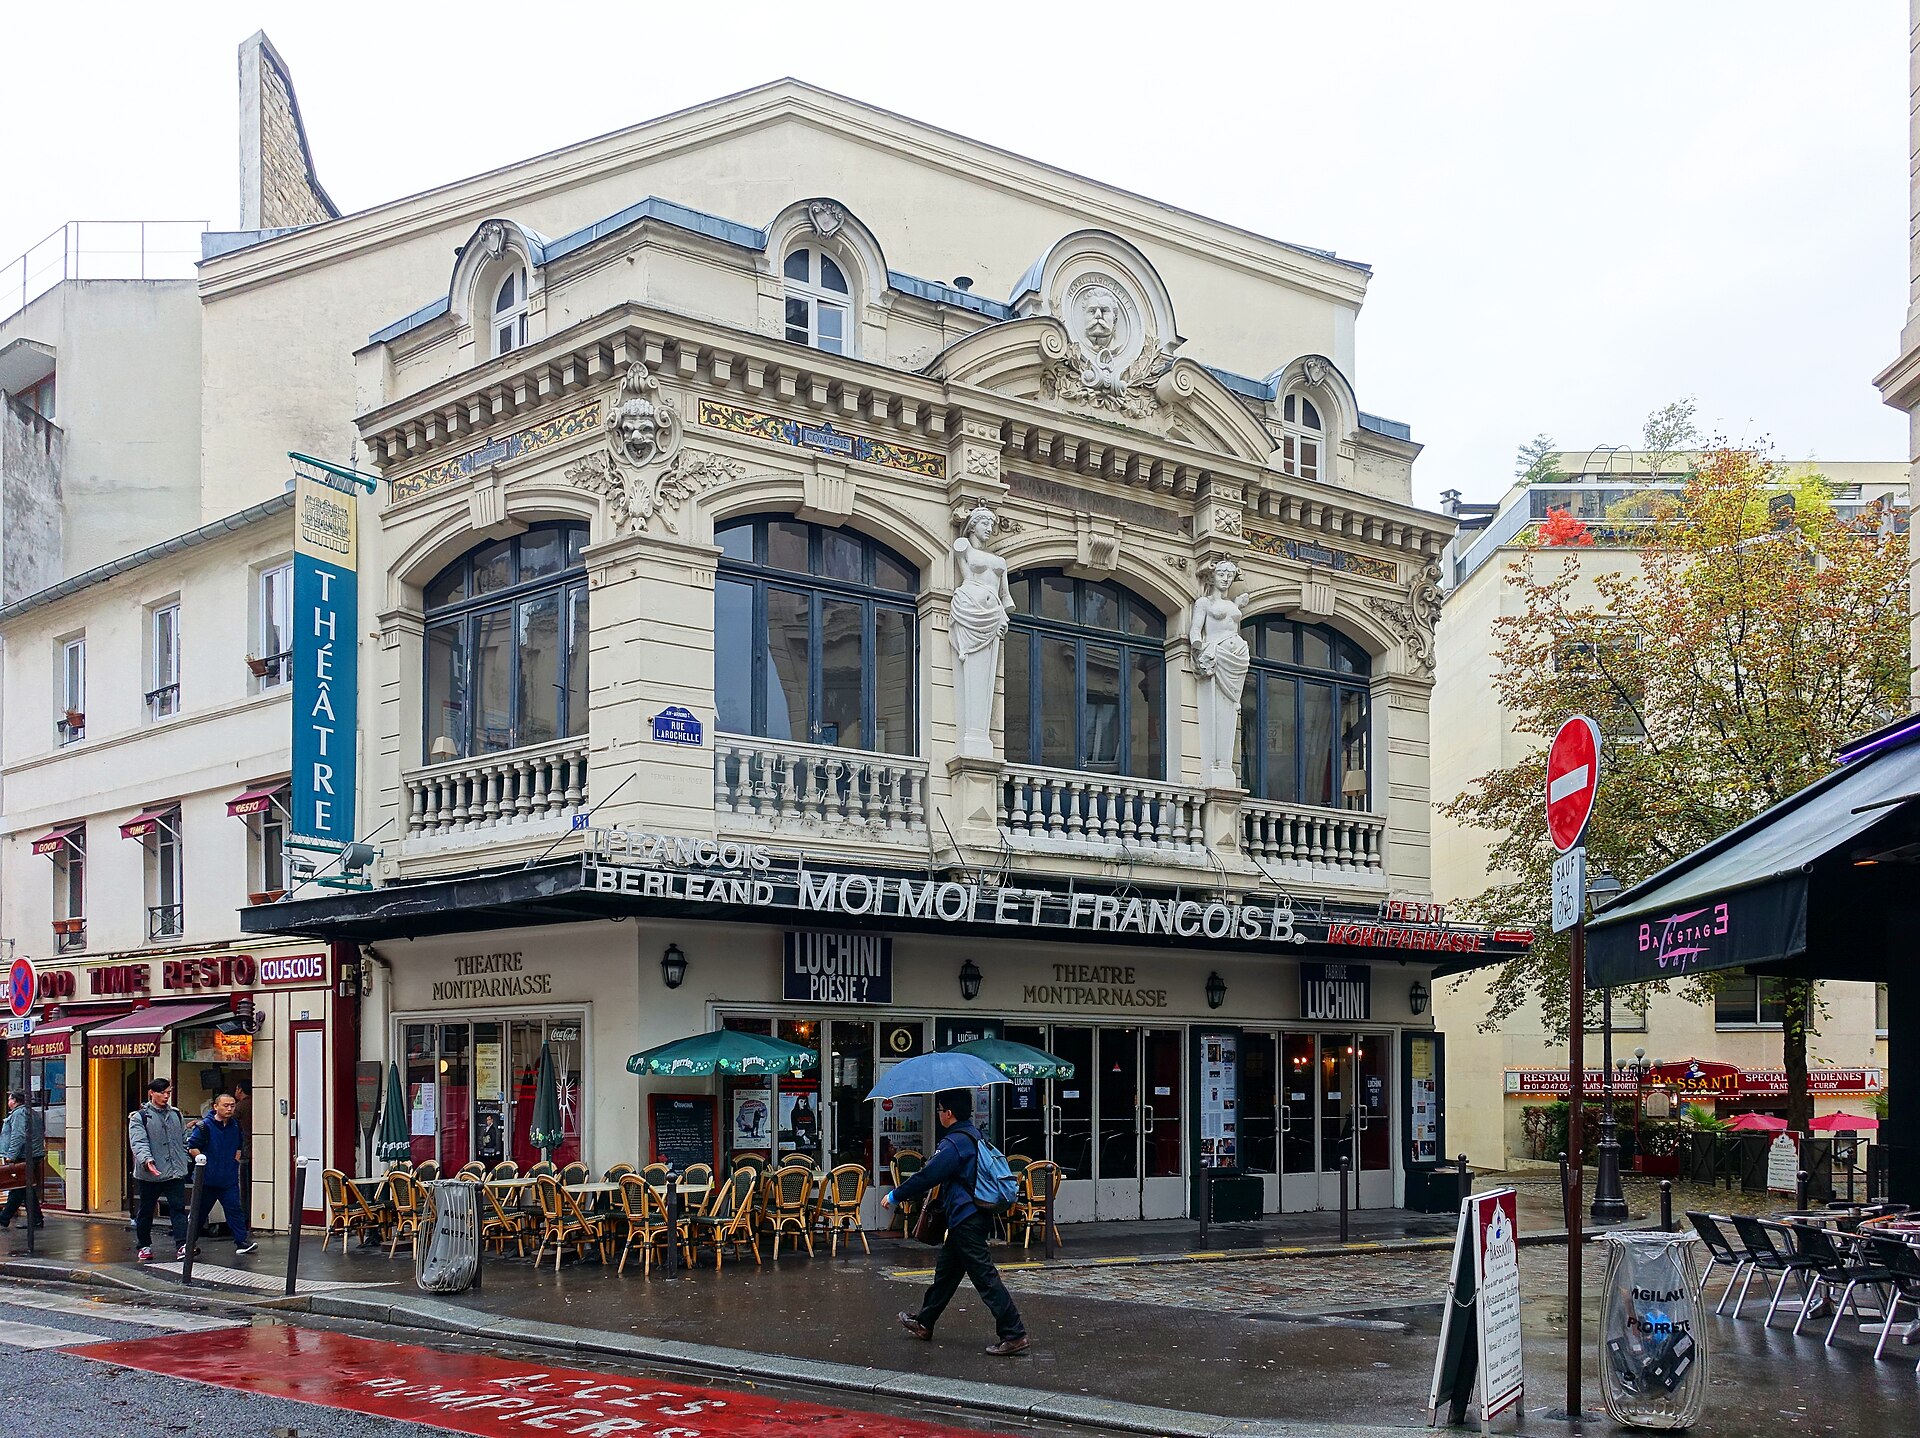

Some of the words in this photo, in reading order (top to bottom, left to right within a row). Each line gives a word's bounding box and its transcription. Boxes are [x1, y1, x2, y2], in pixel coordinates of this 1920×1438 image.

[311, 569, 337, 832] THÉÂTRE
[656, 728, 699, 742] LAROCHELLE
[671, 721, 685, 731] RUE
[235, 801, 259, 814] RESTO
[129, 824, 146, 835] TIME
[38, 843, 57, 852] GOOD
[1556, 855, 1575, 883] SAUF
[596, 867, 775, 906] BERLEAND
[798, 869, 885, 916] MOI
[898, 878, 979, 922] MOI
[996, 887, 1053, 927] ET
[1069, 893, 1264, 941] FRANCOIS
[1386, 900, 1446, 923] PETIT
[1327, 923, 1487, 953] MONTPARNASSE
[454, 951, 523, 976] THEATRE
[794, 931, 882, 977] LUCHINI
[86, 963, 150, 995] TIME
[162, 954, 256, 990] RESTO
[261, 956, 323, 981] COUSCOUS
[1053, 963, 1136, 985] THEATRE
[1325, 964, 1347, 980] FABRICE
[431, 973, 552, 1001] MONTPARNASSE
[810, 972, 857, 1002] POÉSIE
[861, 977, 869, 1003] ?
[1023, 985, 1168, 1008] MONTPARNASSE
[1307, 980, 1365, 1019] LUCHINI
[9, 1022, 24, 1032] SAUF
[30, 1044, 45, 1056] TIME
[46, 1041, 64, 1054] RESTO
[92, 1045, 114, 1055] GOOD
[115, 1044, 132, 1054] TIME
[133, 1042, 156, 1054] RESTO
[1523, 1073, 1598, 1082] RESTAUNT
[1651, 1073, 1739, 1089] BASSANTI
[1810, 1073, 1862, 1081] INDIENNES
[1490, 1236, 1512, 1261] BASSANTI
